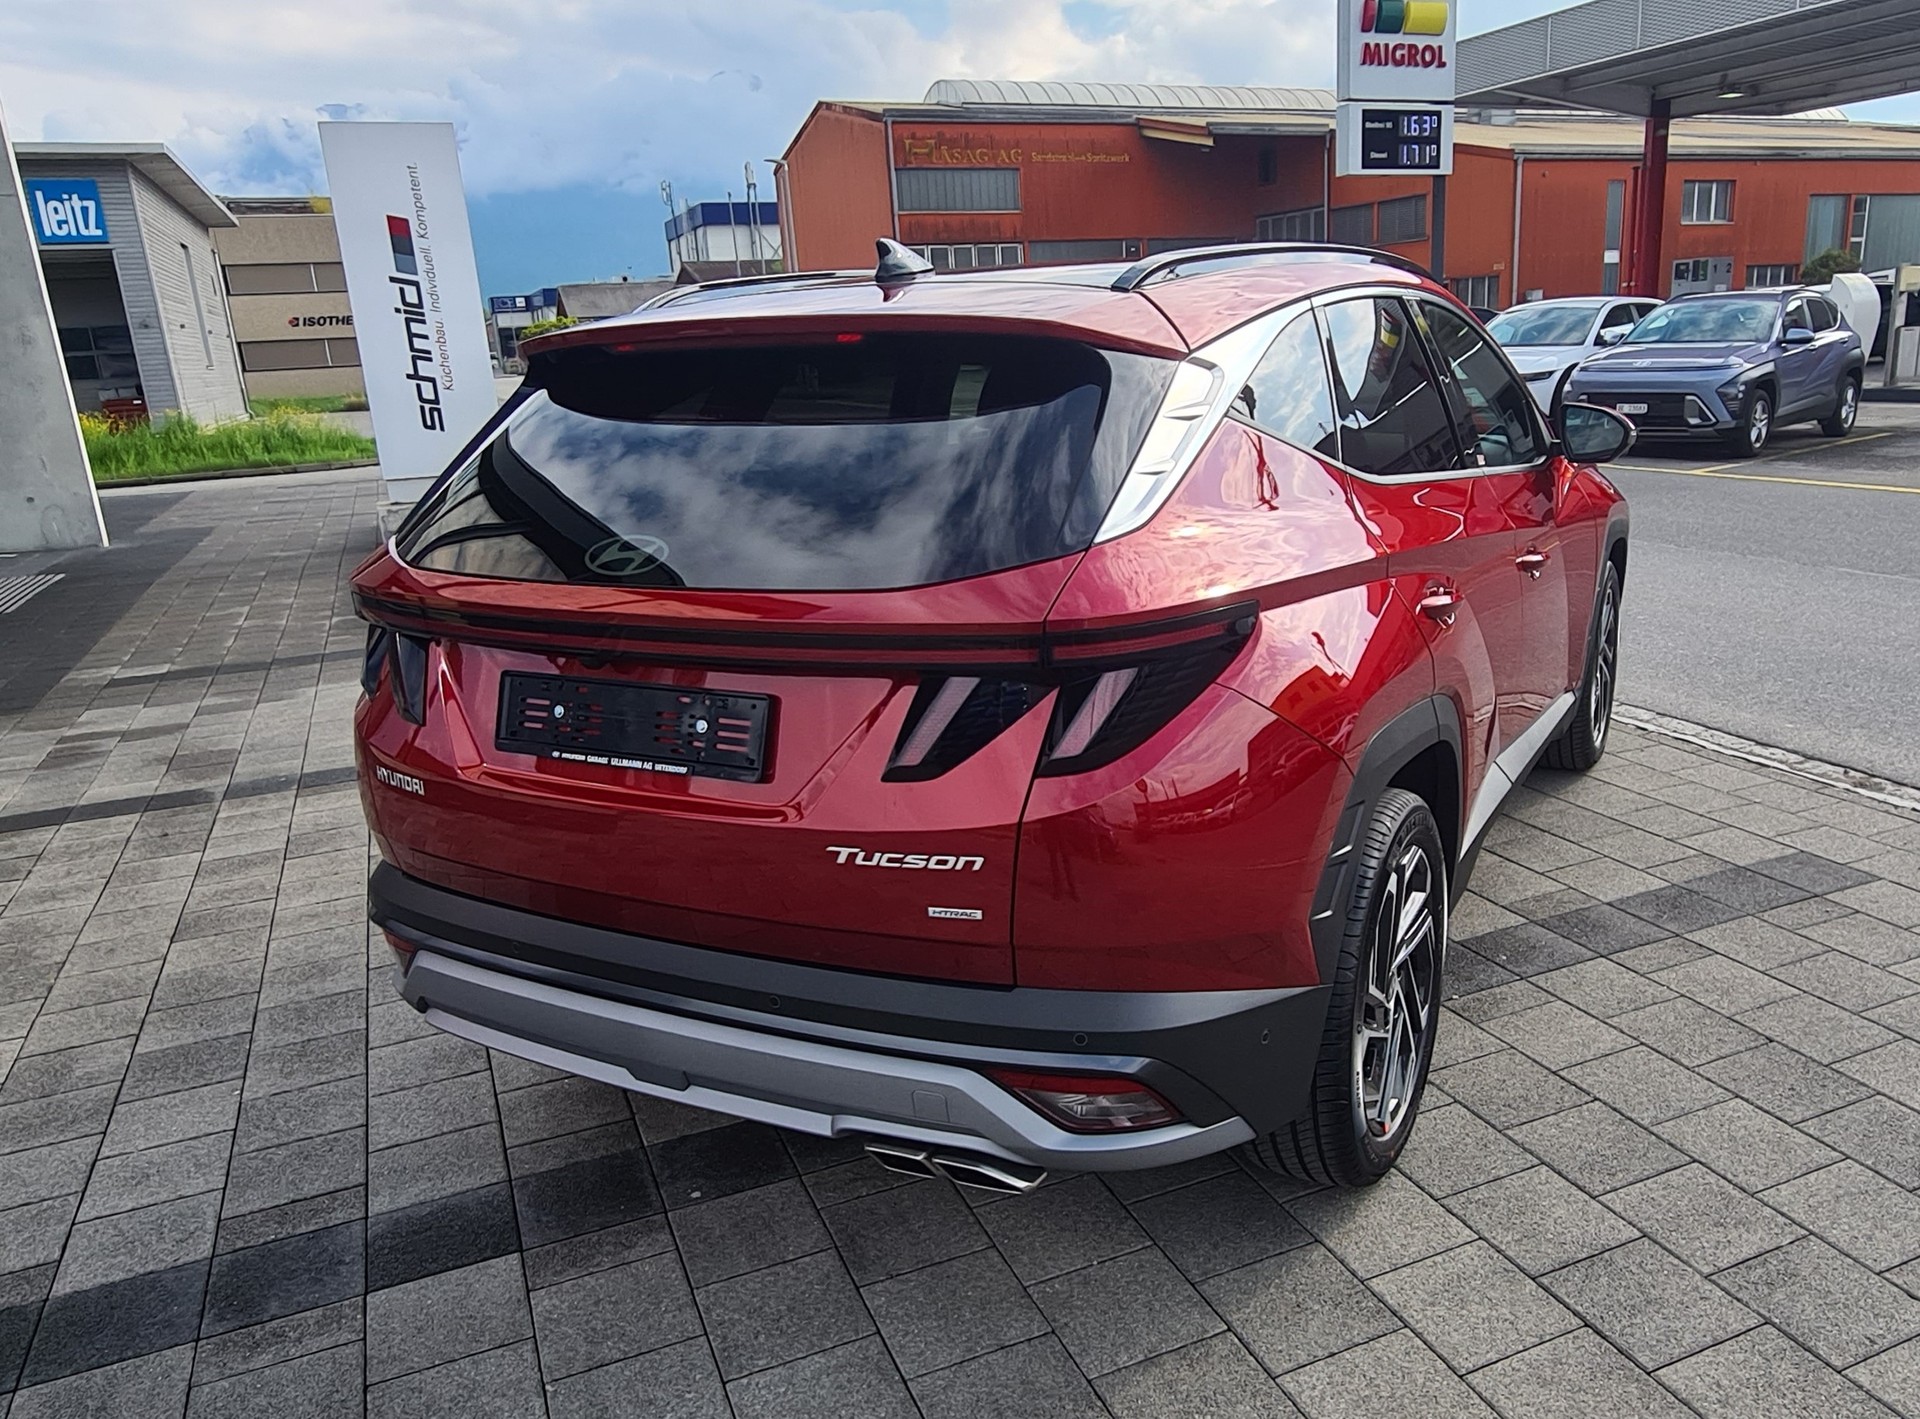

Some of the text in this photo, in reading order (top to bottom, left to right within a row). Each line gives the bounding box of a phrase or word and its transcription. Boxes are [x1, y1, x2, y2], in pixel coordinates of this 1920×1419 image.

[1360, 42, 1447, 68] MIGROL
[997, 148, 1022, 164] AG
[34, 190, 103, 237] leitz
[406, 162, 454, 391] Küchenbau. Individuell. Kompetent.
[388, 275, 445, 432] schmid
[376, 765, 425, 796] HYUNDAI
[931, 909, 979, 919] HTRAC
